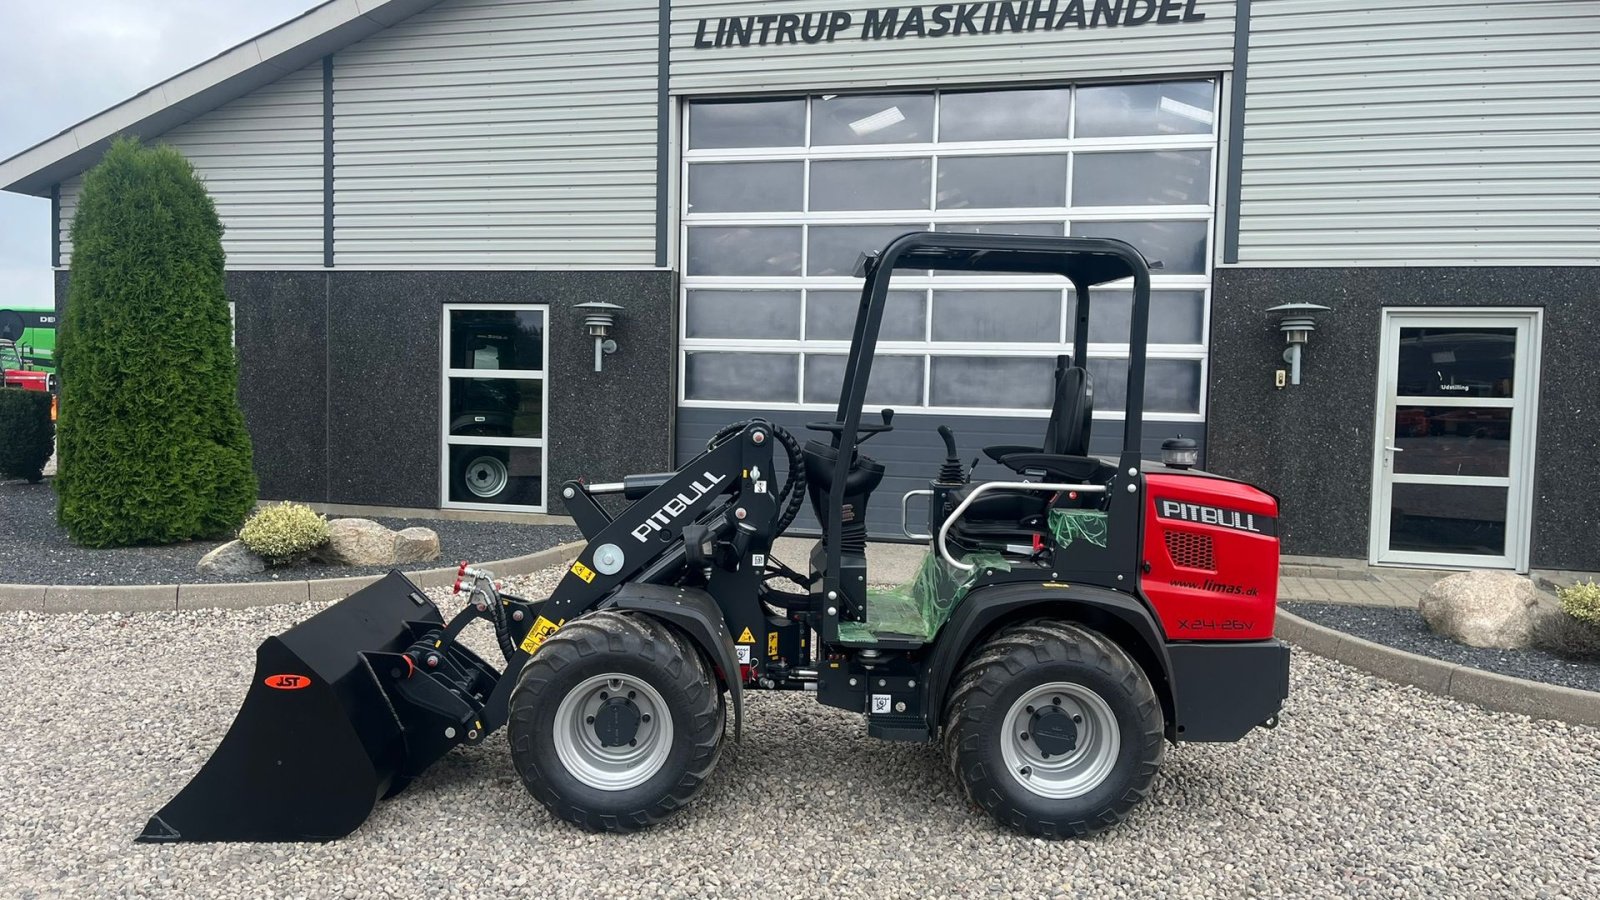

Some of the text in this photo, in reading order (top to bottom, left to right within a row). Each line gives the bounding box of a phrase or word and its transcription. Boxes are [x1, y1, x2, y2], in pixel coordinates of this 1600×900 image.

[694, 0, 1206, 49] LINTRUP MASKINHANDEL
[630, 471, 727, 543] PITBULL
[1163, 500, 1260, 532] PITBULL
[1169, 579, 1259, 597] www.limas.dk
